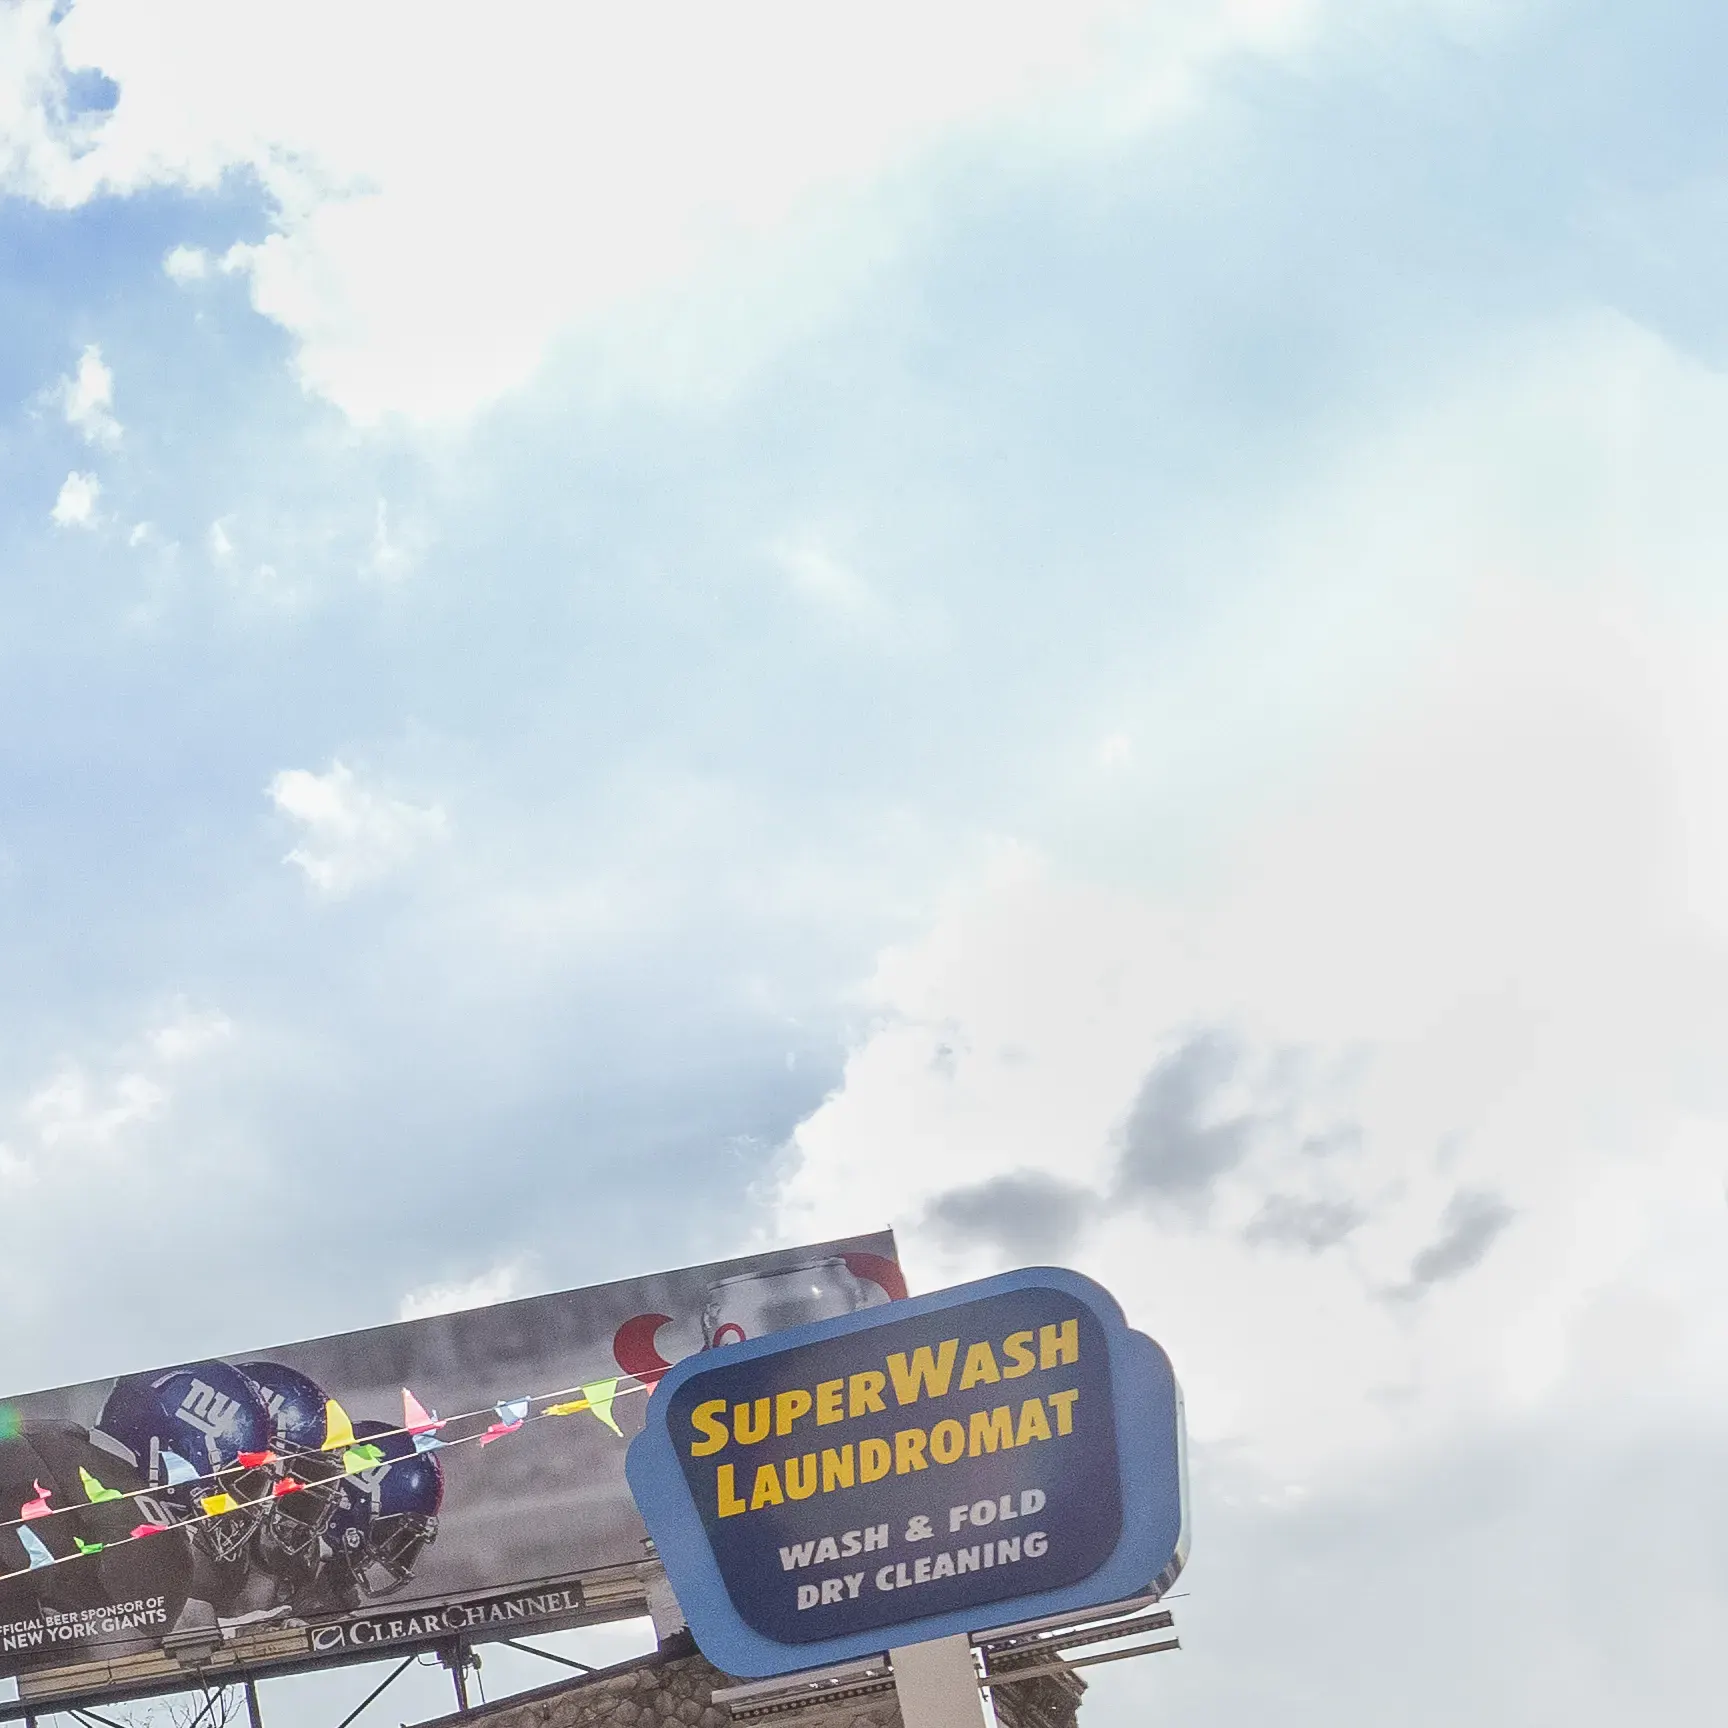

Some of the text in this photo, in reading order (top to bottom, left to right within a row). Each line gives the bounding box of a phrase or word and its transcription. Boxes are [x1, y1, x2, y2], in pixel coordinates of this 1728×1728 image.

[717, 1388, 1079, 1519] LAUNDROMAT
[779, 1488, 1047, 1572] WASH & FOLD
[796, 1530, 1049, 1611] DRY CLEANING
[3, 1630, 44, 1652] NEW
[46, 1620, 99, 1643] YORK
[101, 1608, 168, 1634] GIANTS
[46, 1611, 79, 1628] BEER
[81, 1599, 144, 1622] SPONSOR
[145, 1595, 165, 1610] OF
